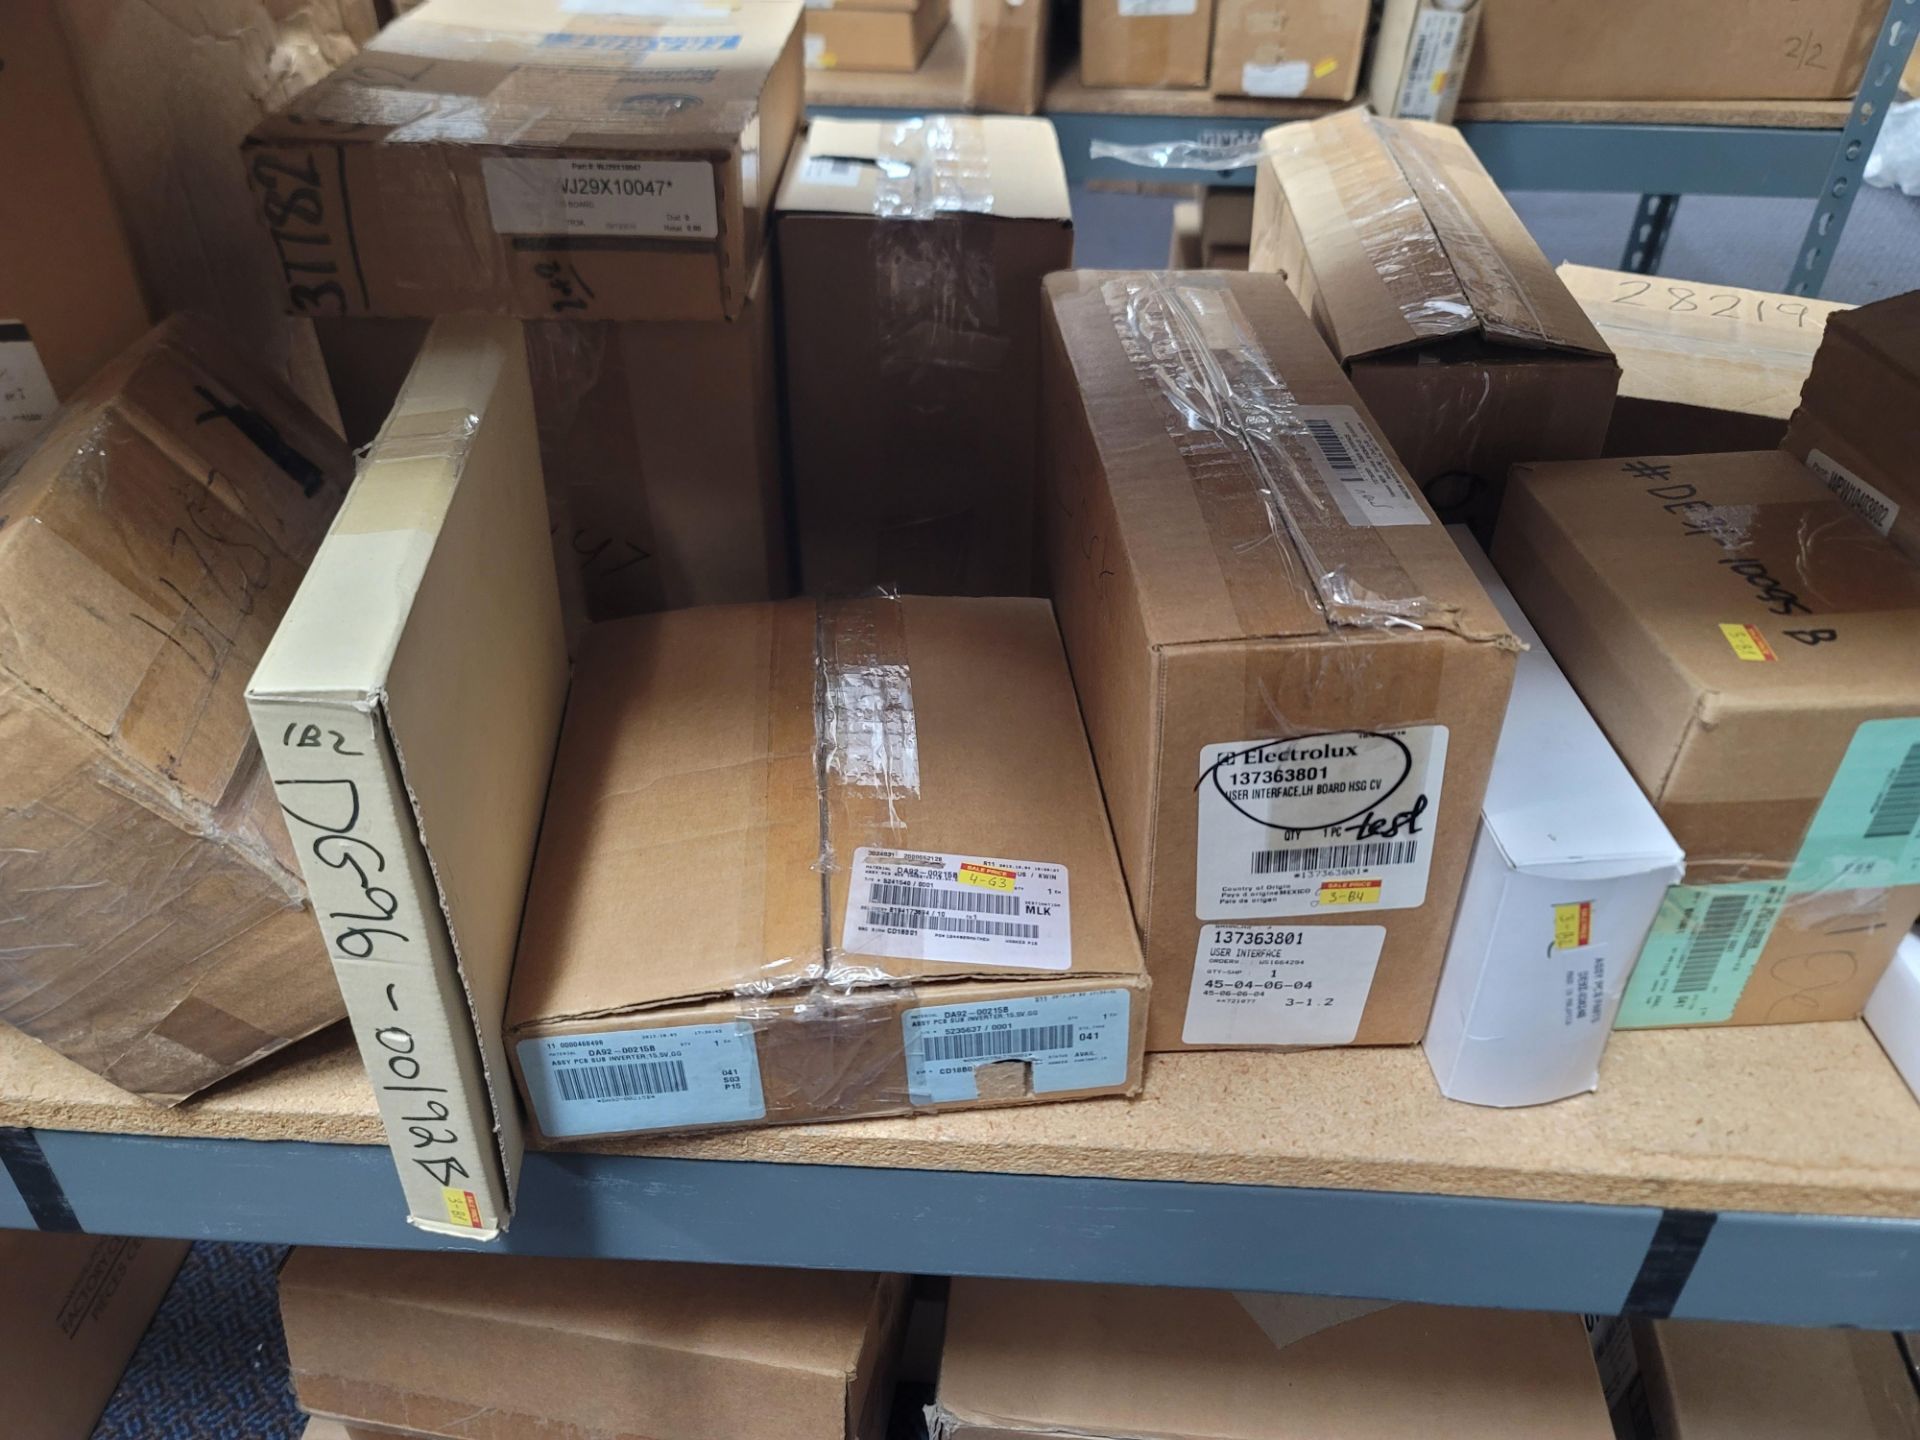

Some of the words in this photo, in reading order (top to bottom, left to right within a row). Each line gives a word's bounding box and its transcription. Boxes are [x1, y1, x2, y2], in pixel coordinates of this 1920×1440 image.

[1784, 29, 1828, 71] 2/2
[1612, 280, 1809, 327] 28219
[1243, 743, 1358, 766] Electrolux
[1229, 766, 1328, 786] 137363801
[1317, 781, 1346, 795] BOARD
[1349, 781, 1367, 793] HSG
[1369, 779, 1382, 791] CV
[1284, 829, 1300, 841] QTY
[1025, 906, 1051, 917] MLK
[1214, 931, 1303, 945] 137363801
[1210, 948, 1231, 957] USER
[1236, 949, 1281, 958] INTERFACE
[1271, 970, 1277, 978] 1
[1204, 980, 1313, 990] 45-04-06-04
[1079, 1032, 1099, 1041] 041
